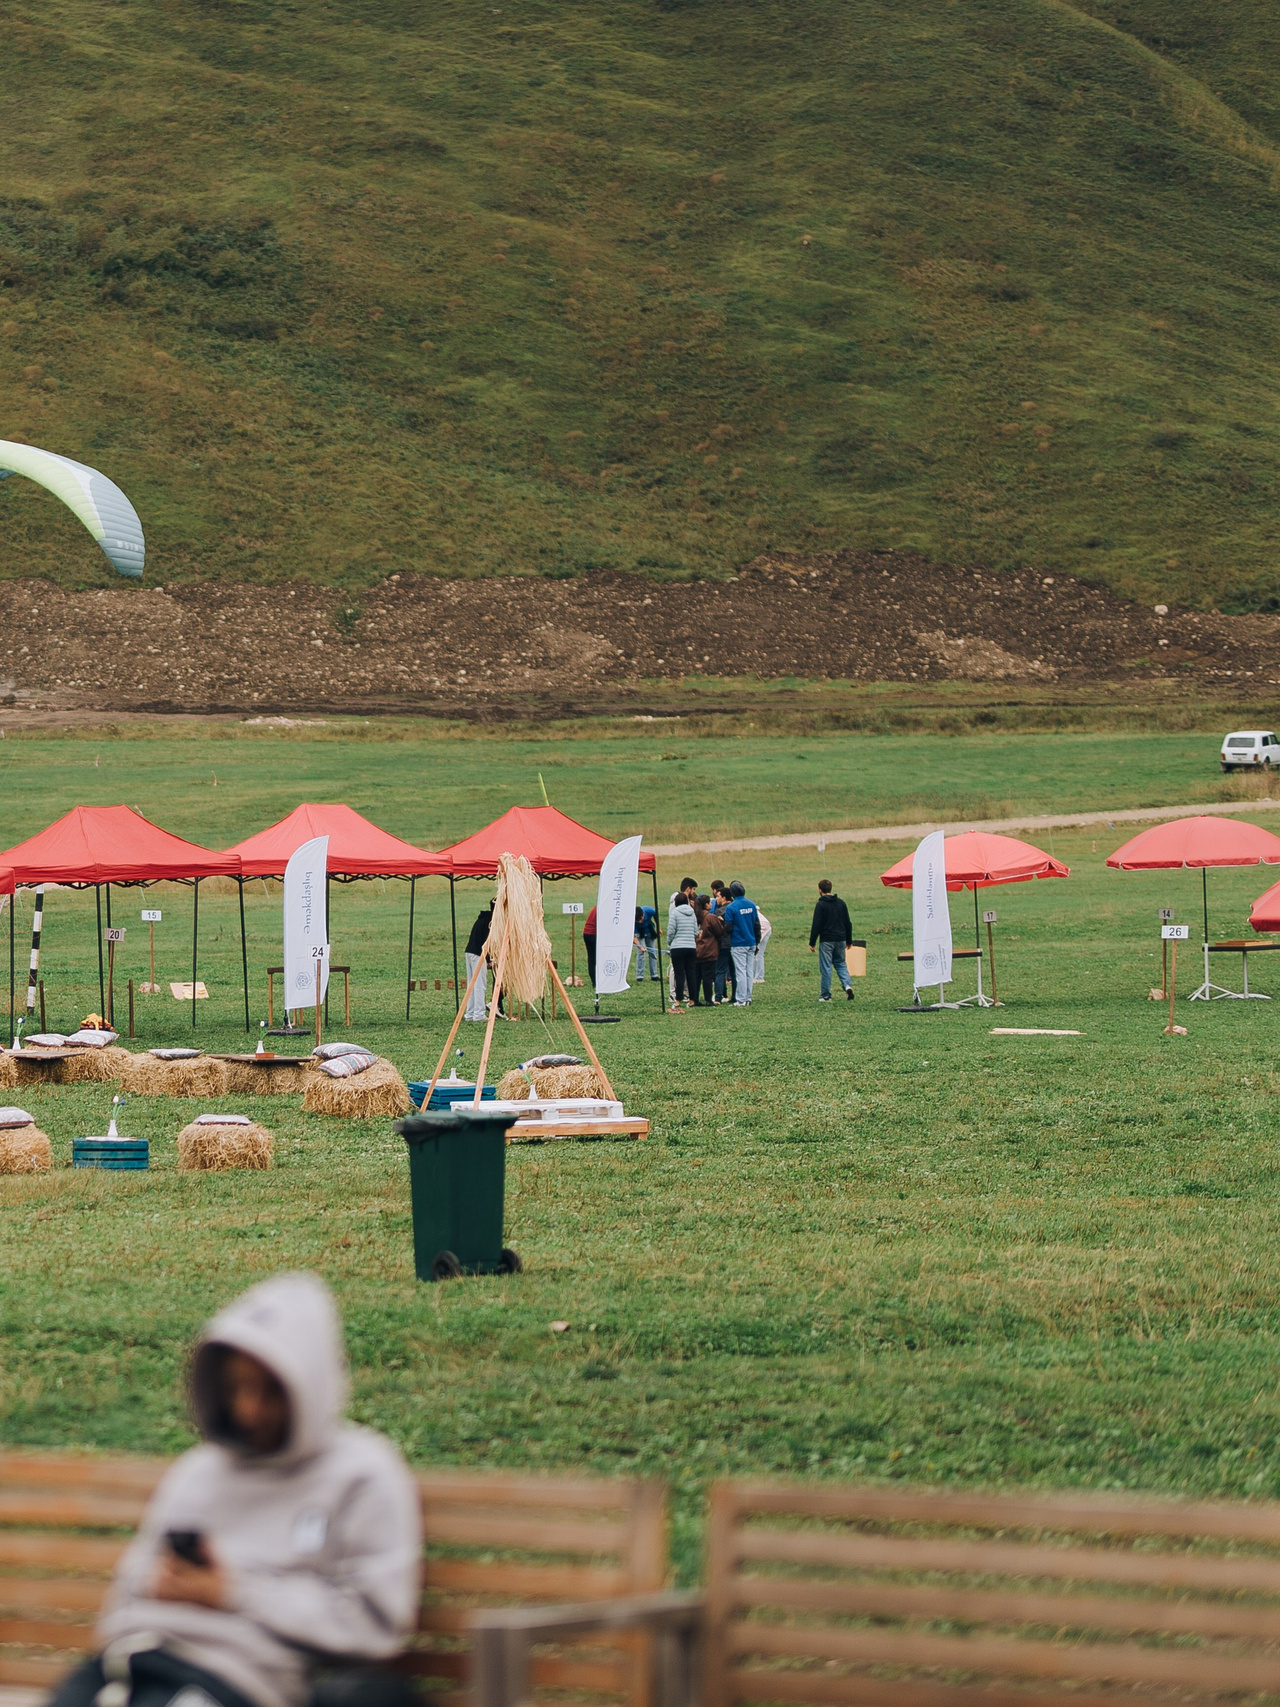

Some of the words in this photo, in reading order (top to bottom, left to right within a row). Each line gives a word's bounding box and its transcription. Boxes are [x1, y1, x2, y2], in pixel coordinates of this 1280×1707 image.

[987, 911, 994, 920] 17
[1162, 910, 1171, 918] 14
[110, 930, 120, 940] 20
[1169, 927, 1182, 937] 26
[312, 946, 324, 957] 24
